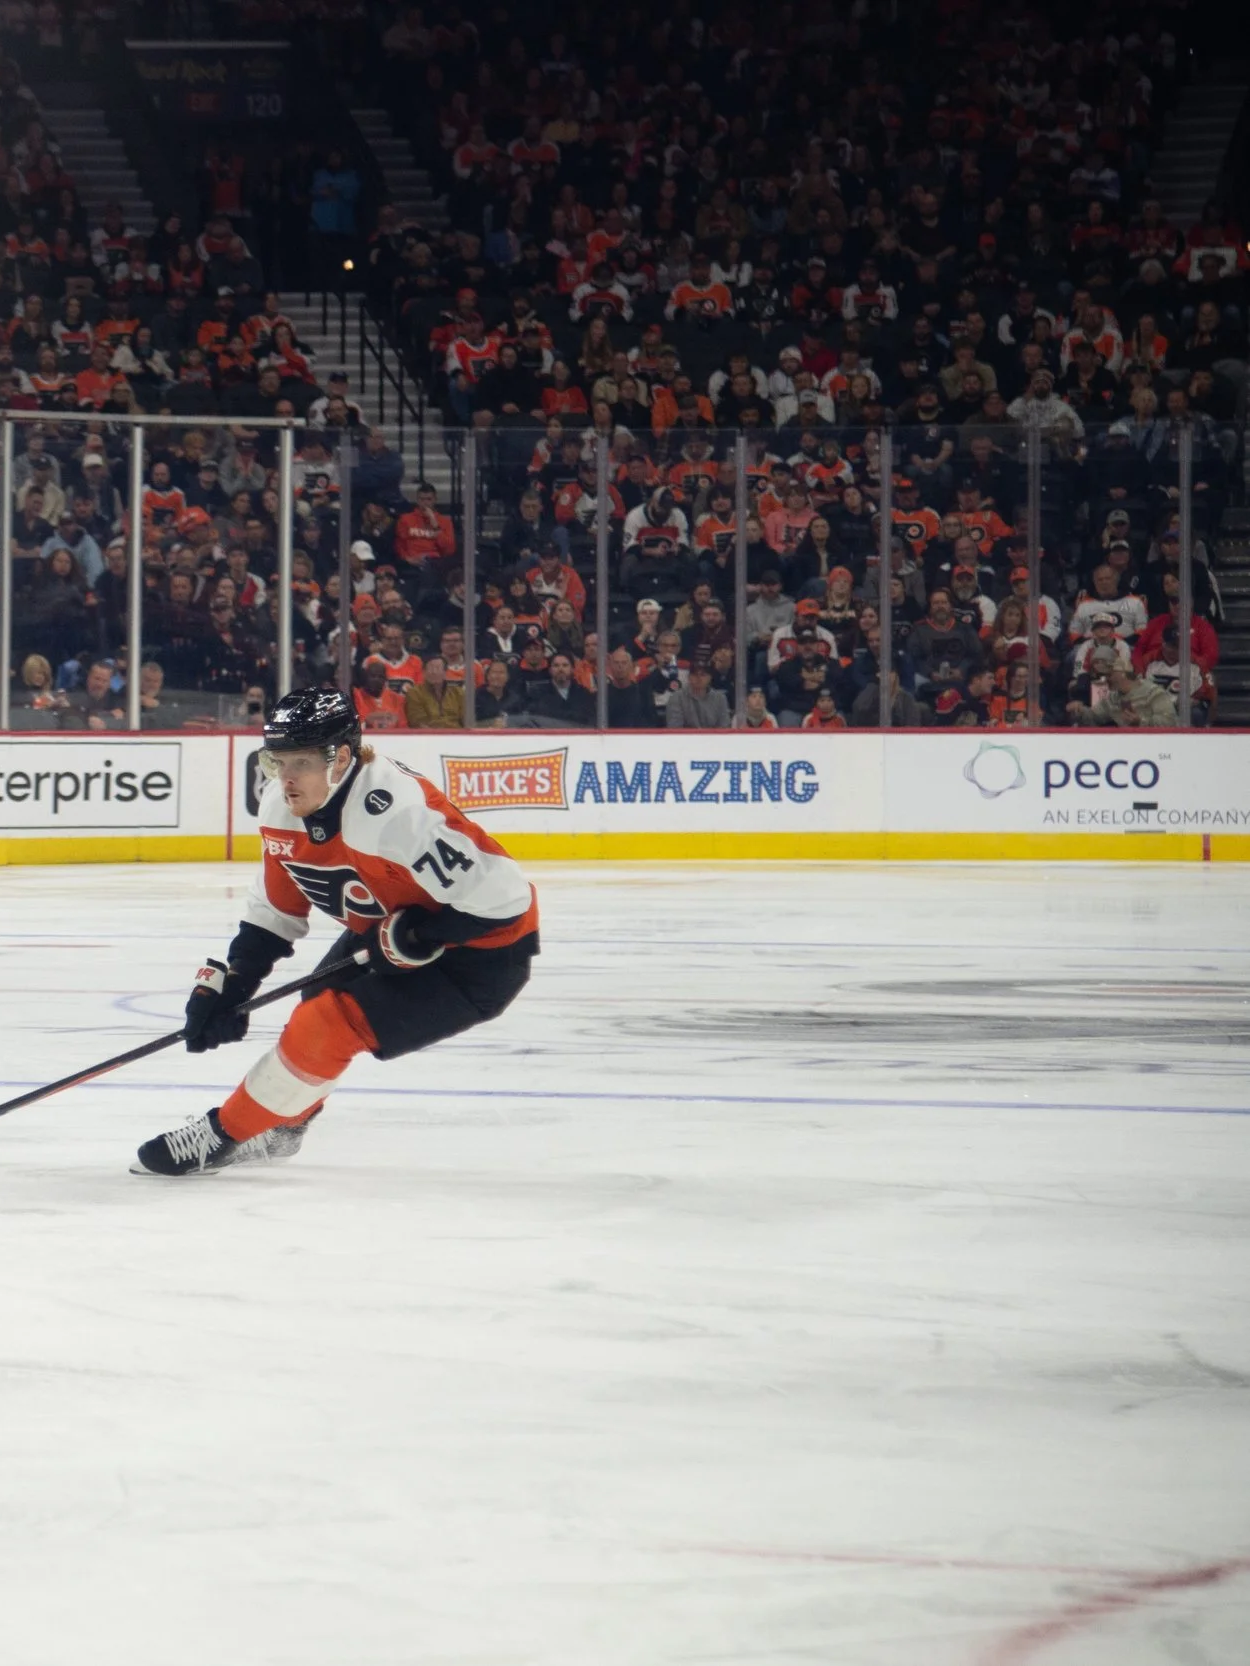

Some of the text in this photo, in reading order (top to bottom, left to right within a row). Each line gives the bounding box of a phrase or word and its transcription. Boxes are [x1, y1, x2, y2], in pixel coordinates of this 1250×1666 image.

[245, 93, 283, 117] 120
[458, 760, 820, 804] MIKE'S AMAZING
[1042, 758, 1160, 799] peco
[1042, 808, 1250, 826] AN EXELON COMPANY
[412, 838, 475, 890] 74
